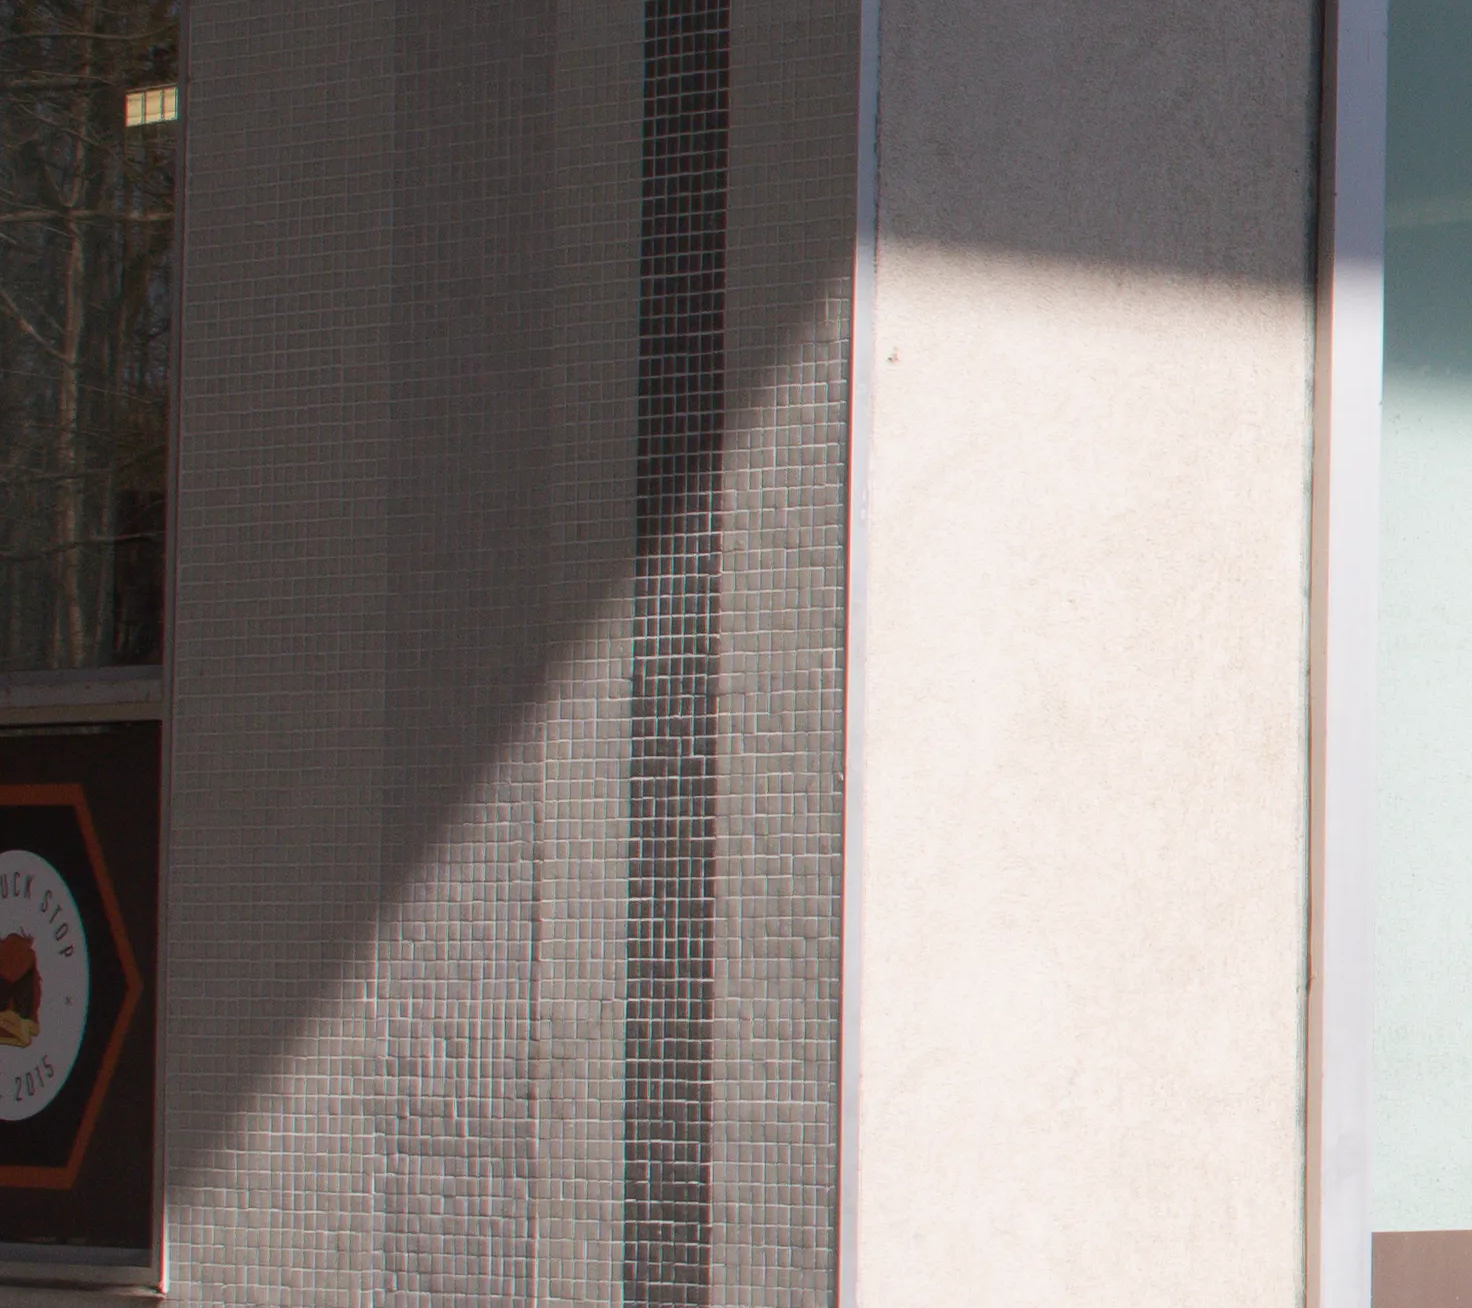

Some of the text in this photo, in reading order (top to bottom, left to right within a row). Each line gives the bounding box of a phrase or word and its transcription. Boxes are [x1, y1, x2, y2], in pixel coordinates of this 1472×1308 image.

[0, 871, 74, 958] UCK STOP
[15, 1054, 55, 1102] 2015
